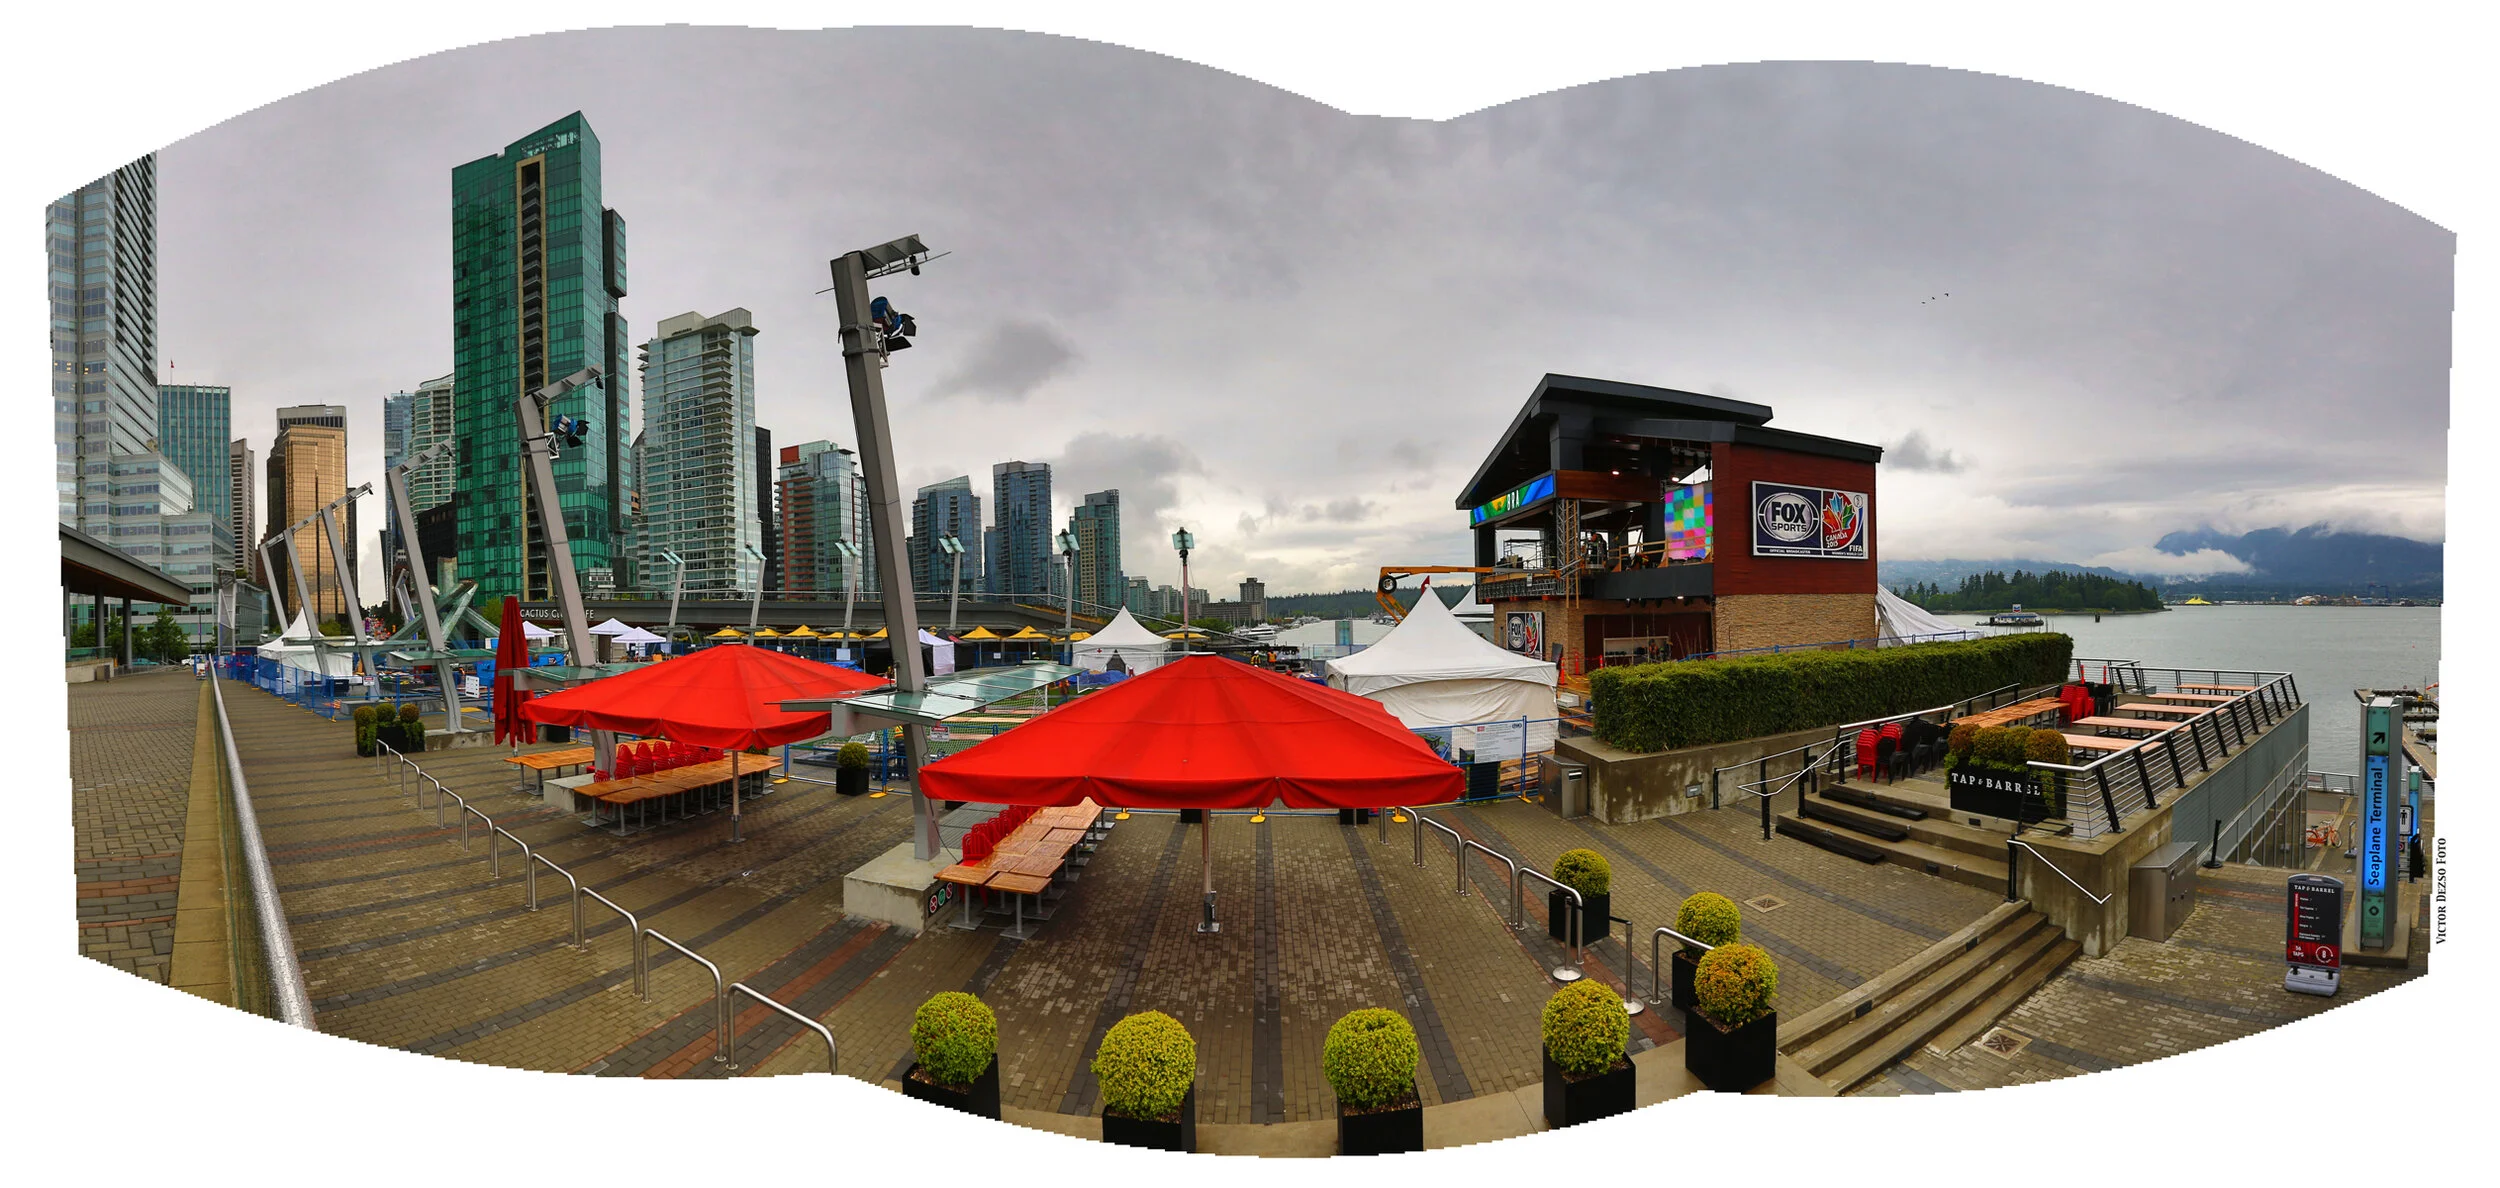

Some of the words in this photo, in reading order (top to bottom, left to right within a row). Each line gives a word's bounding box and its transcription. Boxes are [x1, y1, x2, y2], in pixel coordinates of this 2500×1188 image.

[1506, 489, 1520, 511] BRA
[1771, 501, 1807, 523] FOX
[1771, 522, 1807, 533] SPORTS
[1826, 532, 1848, 542] CANADA
[1848, 544, 1863, 553] FIFA
[520, 609, 549, 618] CACTUS
[1951, 773, 1975, 785] TAP
[2369, 767, 2383, 824] Terminal
[2367, 827, 2383, 886] Seaplane
[2311, 886, 2335, 894] BARREL
